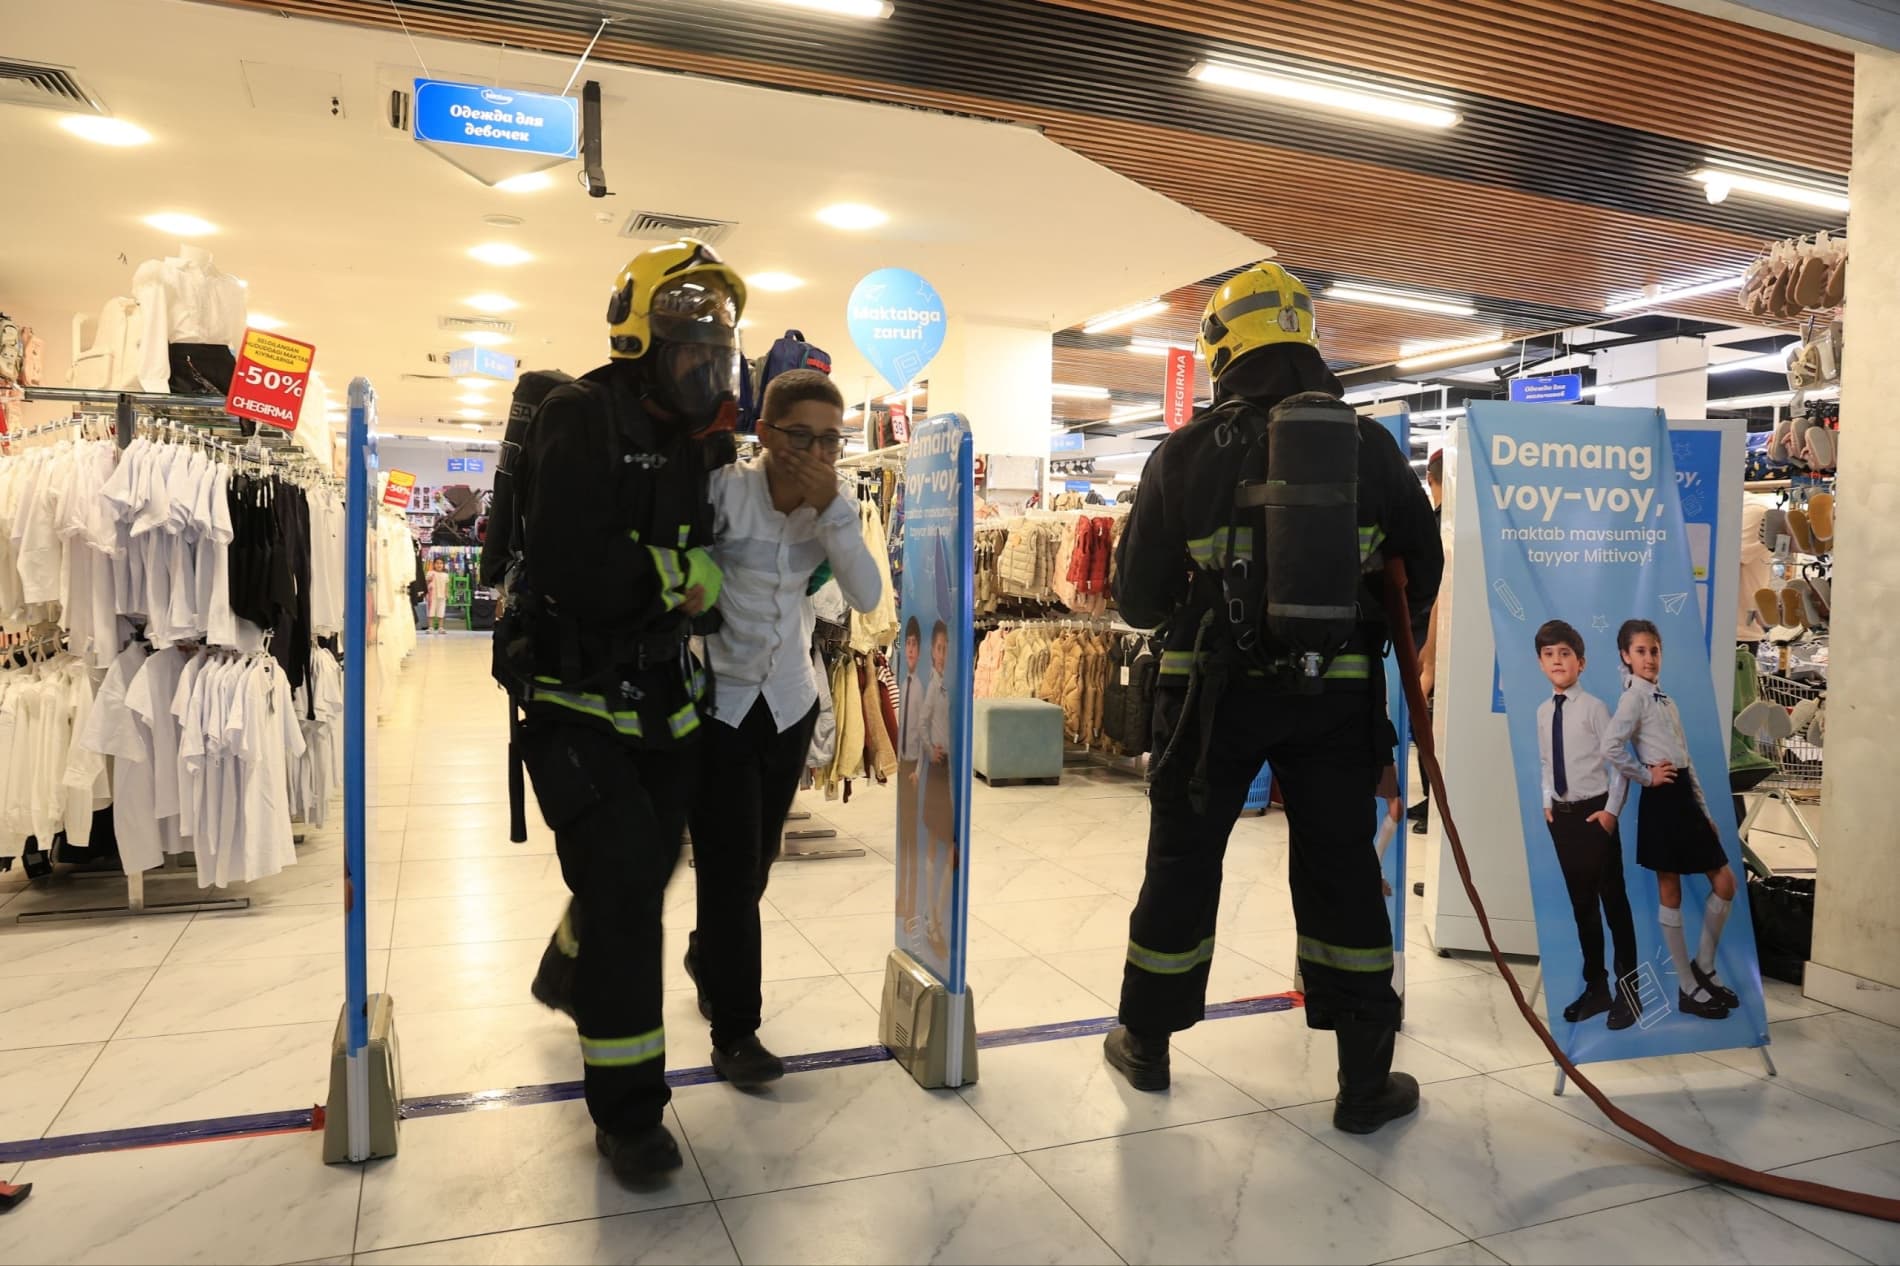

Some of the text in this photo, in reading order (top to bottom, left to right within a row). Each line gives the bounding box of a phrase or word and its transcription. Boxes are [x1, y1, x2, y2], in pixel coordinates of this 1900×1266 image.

[449, 104, 544, 128] Одежда для
[464, 123, 529, 142] девочек
[853, 306, 941, 326] Maktabga
[873, 325, 923, 340] zaruri
[237, 366, 303, 397] -50%
[1174, 355, 1186, 425] CHEGIRMA
[232, 396, 294, 422] CHEGIRMA
[1491, 434, 1652, 481] Demang
[1491, 484, 1665, 523] voy-voy,
[1501, 526, 1667, 547] maktab mavsumiga
[1527, 548, 1653, 567] tayyor Mittivoy!
